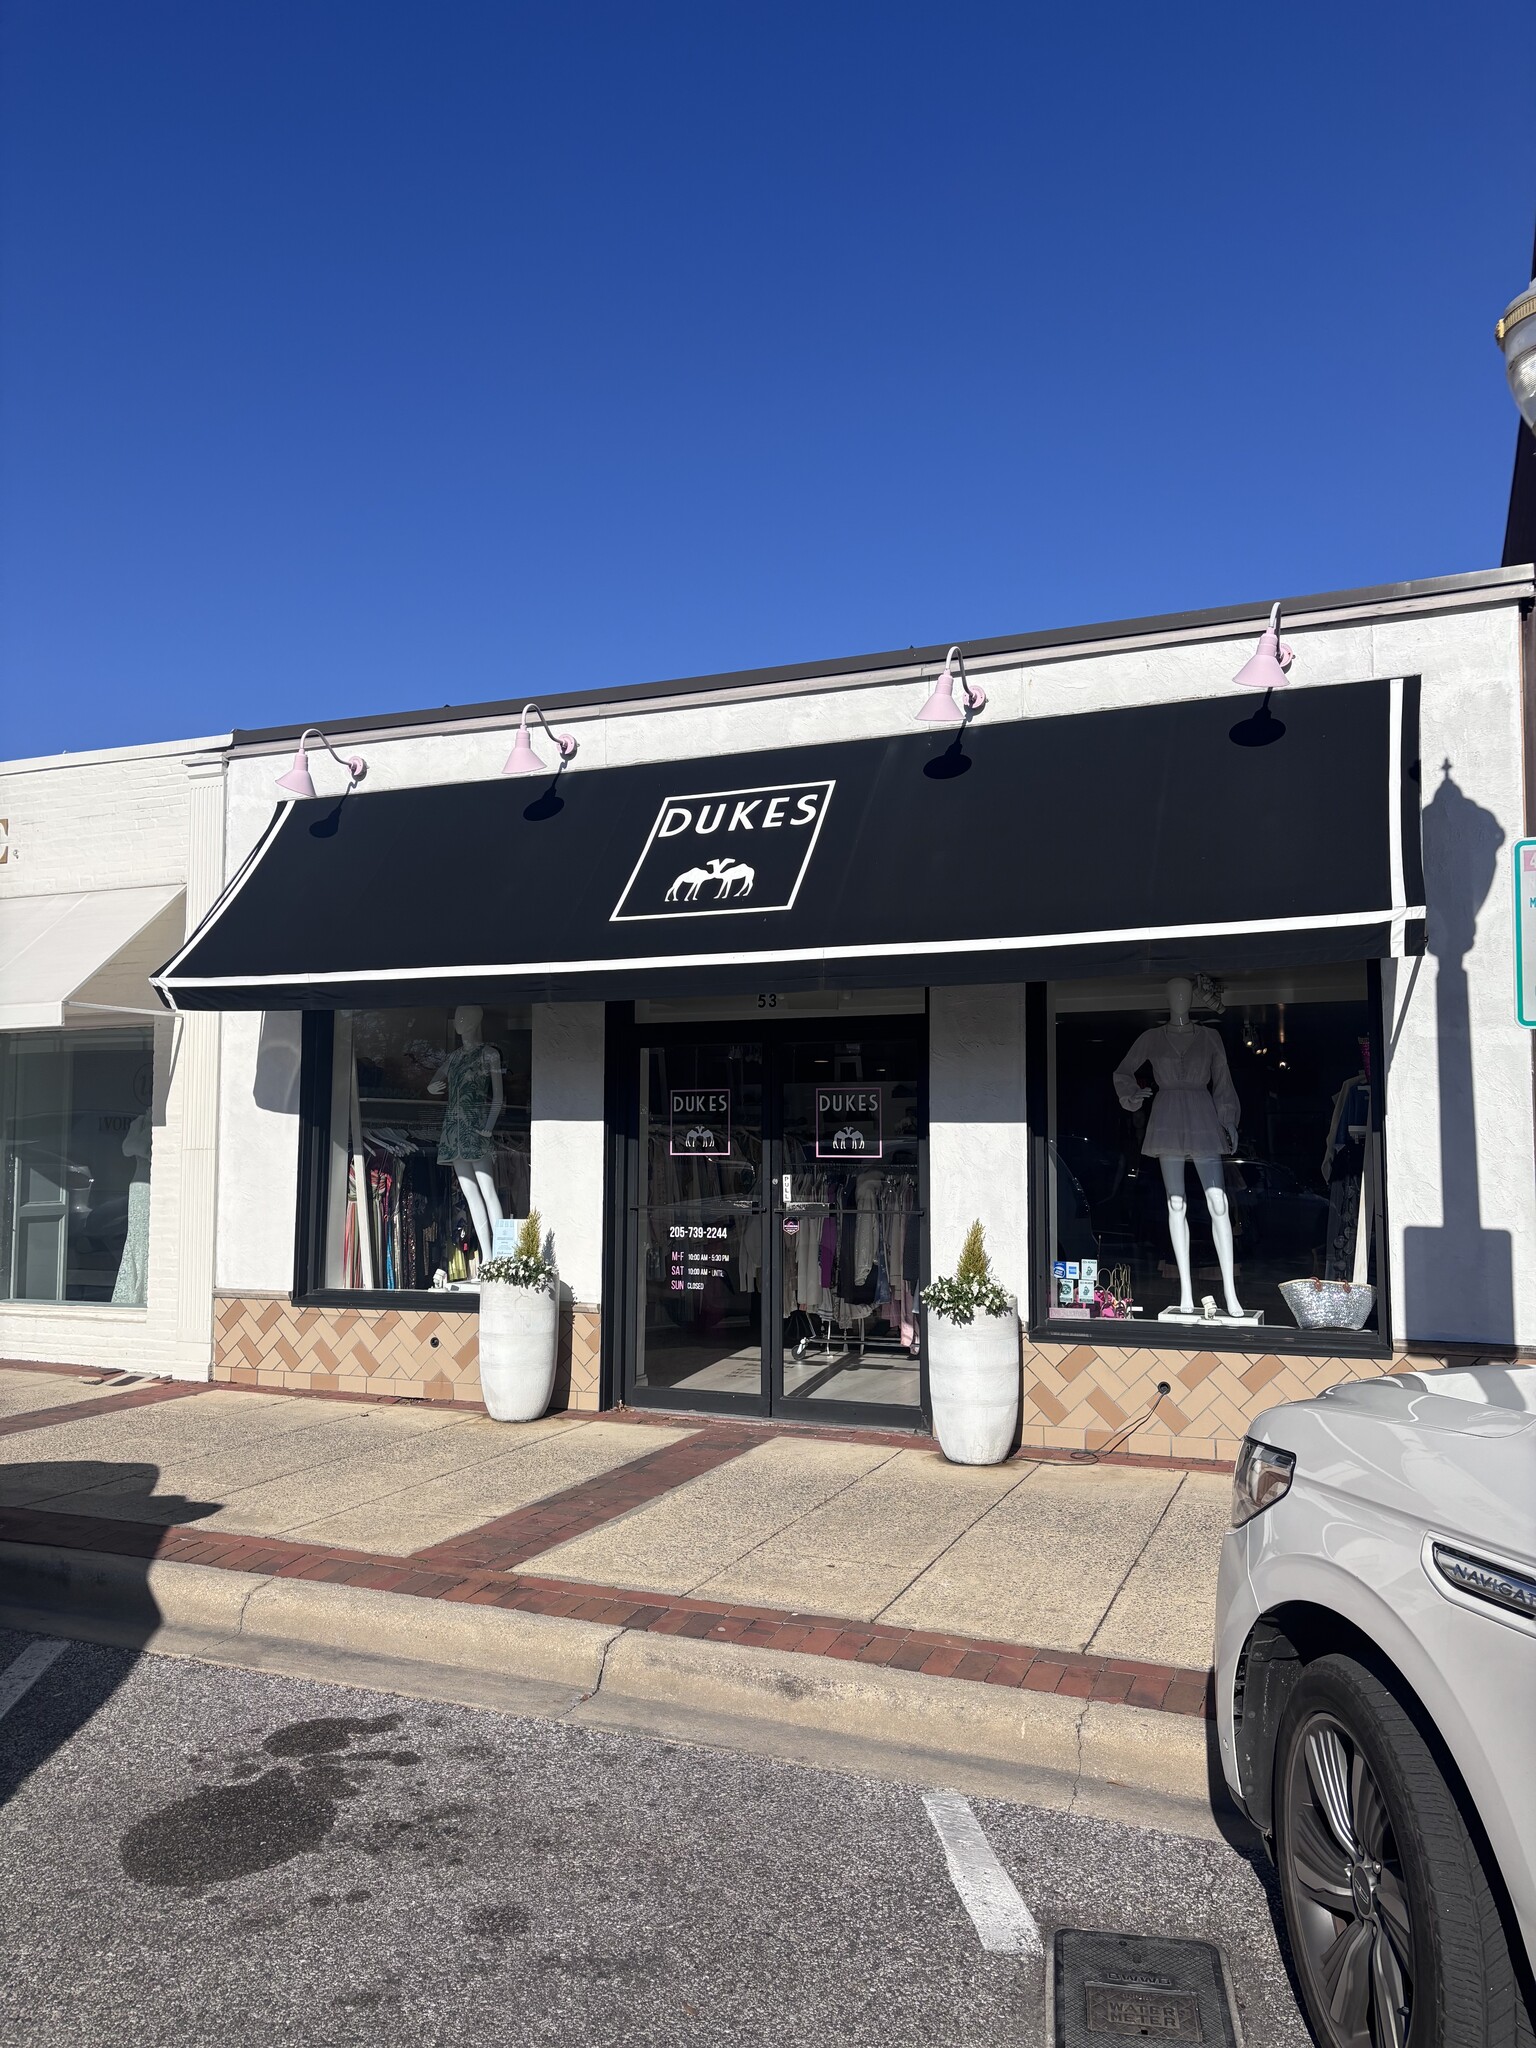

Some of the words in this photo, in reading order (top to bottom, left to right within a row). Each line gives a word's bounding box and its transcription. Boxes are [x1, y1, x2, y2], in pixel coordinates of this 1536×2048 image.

[658, 794, 818, 837] DUKES
[757, 994, 777, 1008] 53
[673, 1095, 727, 1112] DUKES
[819, 1094, 878, 1112] DUKES
[669, 1226, 727, 1239] 205-739-2244
[671, 1251, 684, 1261] M-F
[688, 1253, 700, 1261] 10:00
[722, 1254, 730, 1262] PM
[671, 1265, 684, 1276] SAT
[688, 1267, 700, 1275] 10:00
[701, 1268, 708, 1276] AM
[671, 1280, 684, 1290] SUN
[687, 1282, 705, 1290] CLOSED
[1452, 1563, 1536, 1607] NAVIGAT
[1109, 2002, 1177, 2017] WATER
[1110, 2012, 1177, 2027] METER
